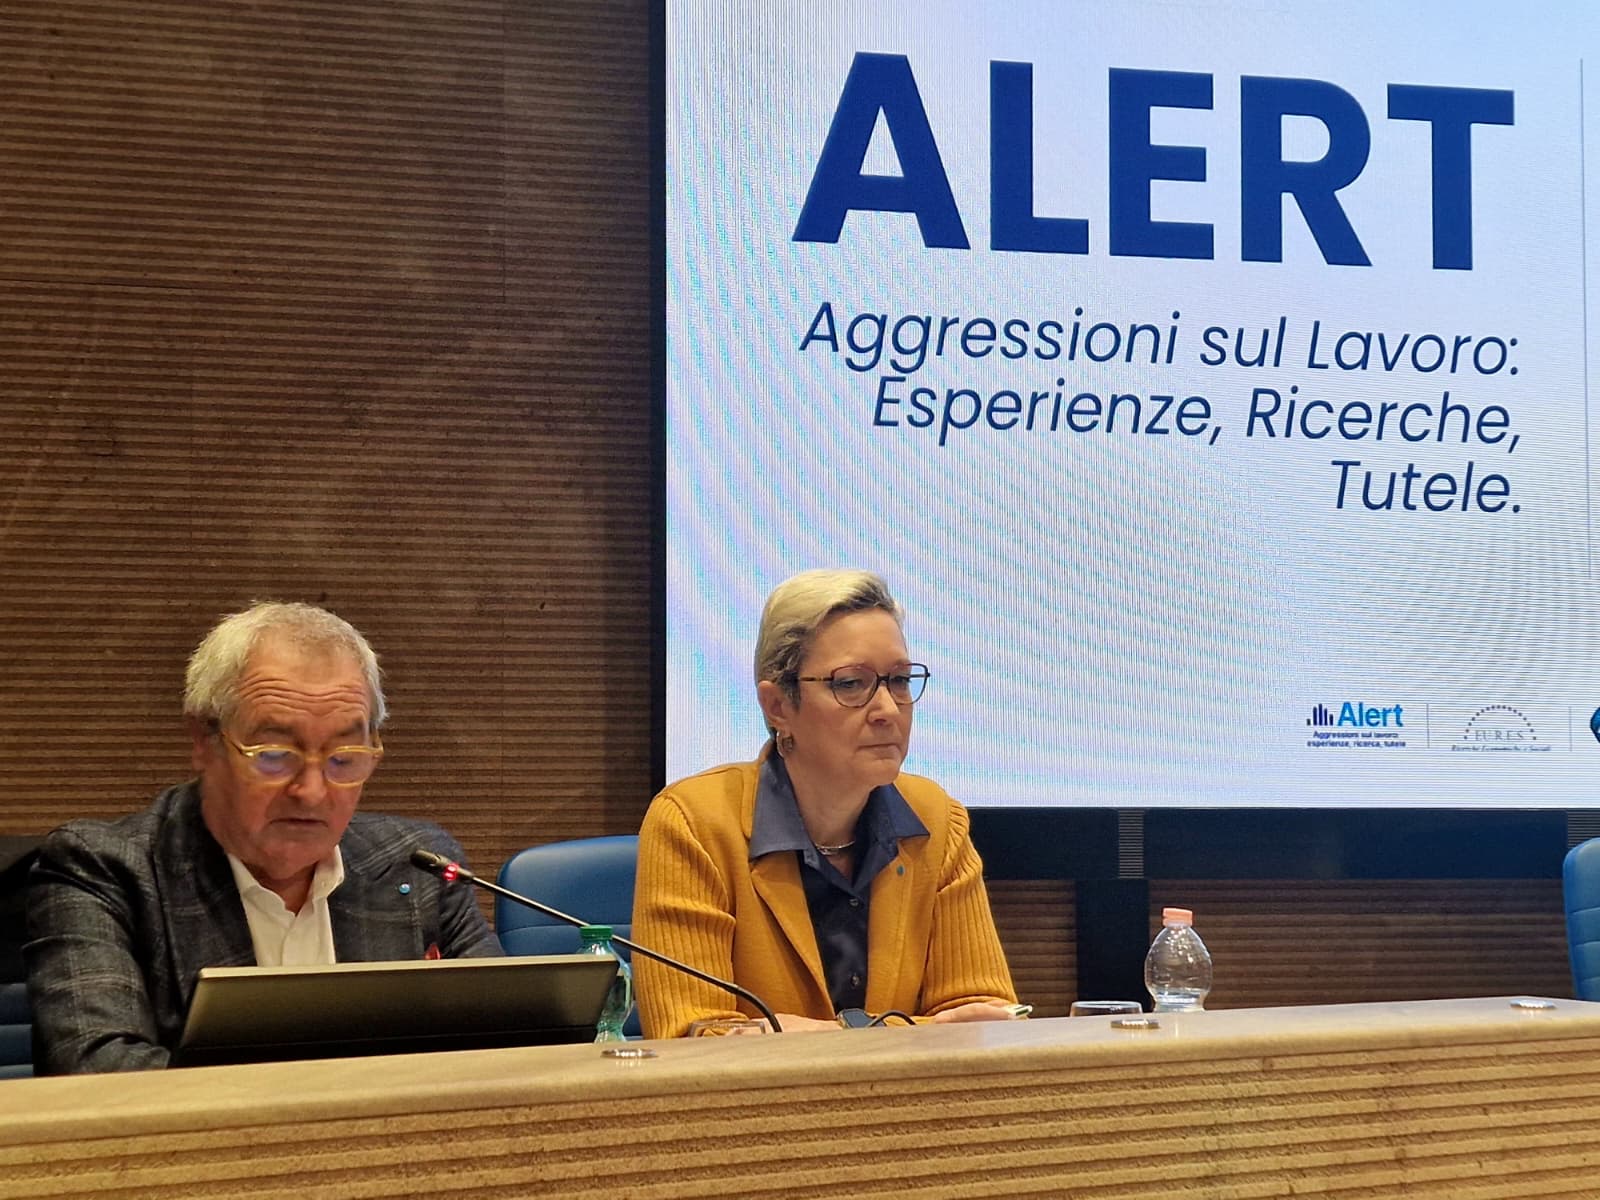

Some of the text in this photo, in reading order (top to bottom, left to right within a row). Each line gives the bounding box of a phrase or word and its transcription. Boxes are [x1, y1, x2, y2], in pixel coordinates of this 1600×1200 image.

[792, 52, 1514, 270] ALERT
[799, 302, 1518, 376] Aggressioni sul Lavoro:
[874, 376, 1521, 454] Esperienze, Ricerche,
[1331, 461, 1521, 514] Tutele.
[1337, 701, 1404, 727] Alert
